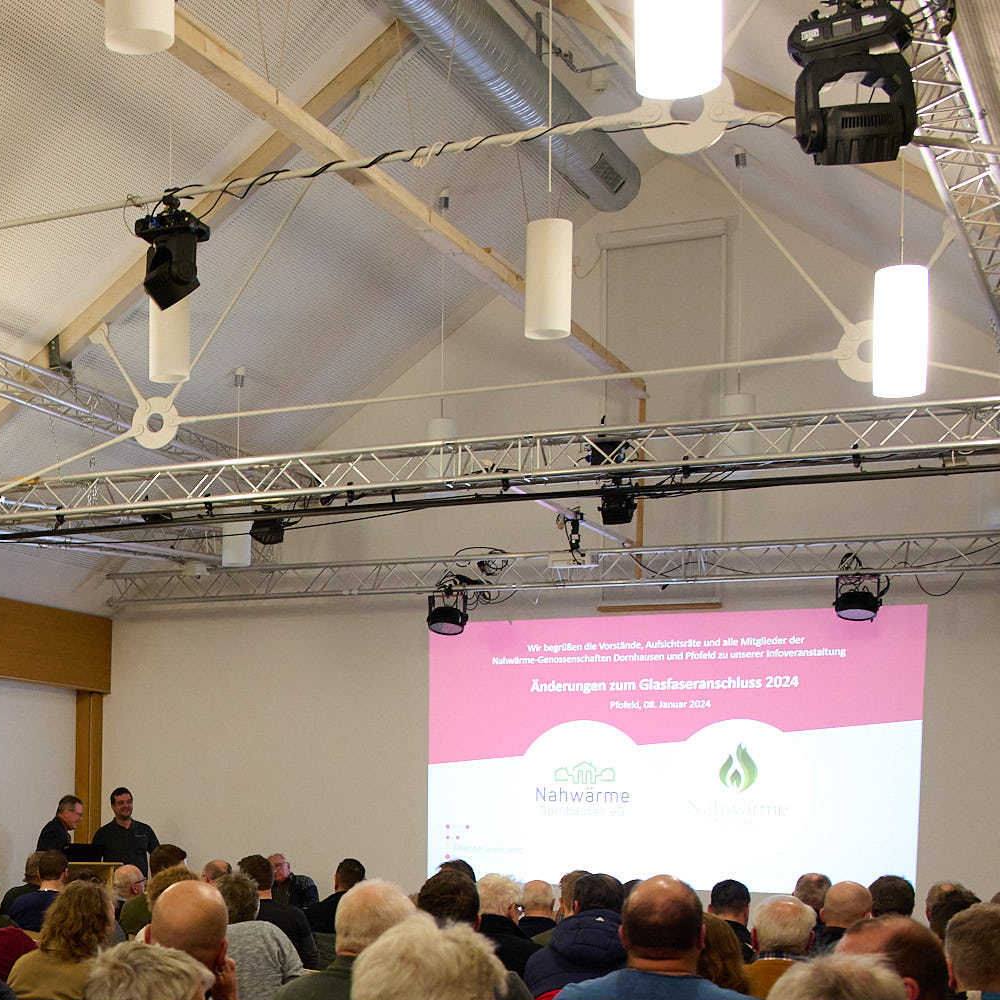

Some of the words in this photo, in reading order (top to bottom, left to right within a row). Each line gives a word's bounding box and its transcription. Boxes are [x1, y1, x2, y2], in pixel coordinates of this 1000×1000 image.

[527, 644, 542, 652] Wir
[544, 643, 582, 654] begrüßen
[584, 642, 597, 651] die
[599, 641, 643, 651] Vorstände,
[645, 639, 702, 649] Aufsichtsräte
[703, 638, 721, 647] und
[722, 637, 738, 646] alle
[740, 636, 787, 648] Mitglieder
[789, 635, 805, 645] der
[492, 653, 612, 665] Nahwärme-Genossenschaften
[613, 652, 665, 663] Dornhausen
[667, 651, 684, 660] und
[685, 650, 716, 660] Pfofeld
[717, 651, 728, 659] zu
[730, 650, 764, 659] unserer
[766, 648, 846, 658] Infoveranstaltung
[530, 678, 606, 694] Änderungen
[609, 680, 636, 691] zum
[638, 677, 762, 691] Glasfaseranschluss
[765, 675, 800, 689] 2024
[609, 700, 641, 710] Pfofeld,
[643, 700, 658, 709] 08.
[659, 700, 687, 709] Januar
[689, 699, 711, 709] 2024
[535, 786, 630, 803] Nahwärme
